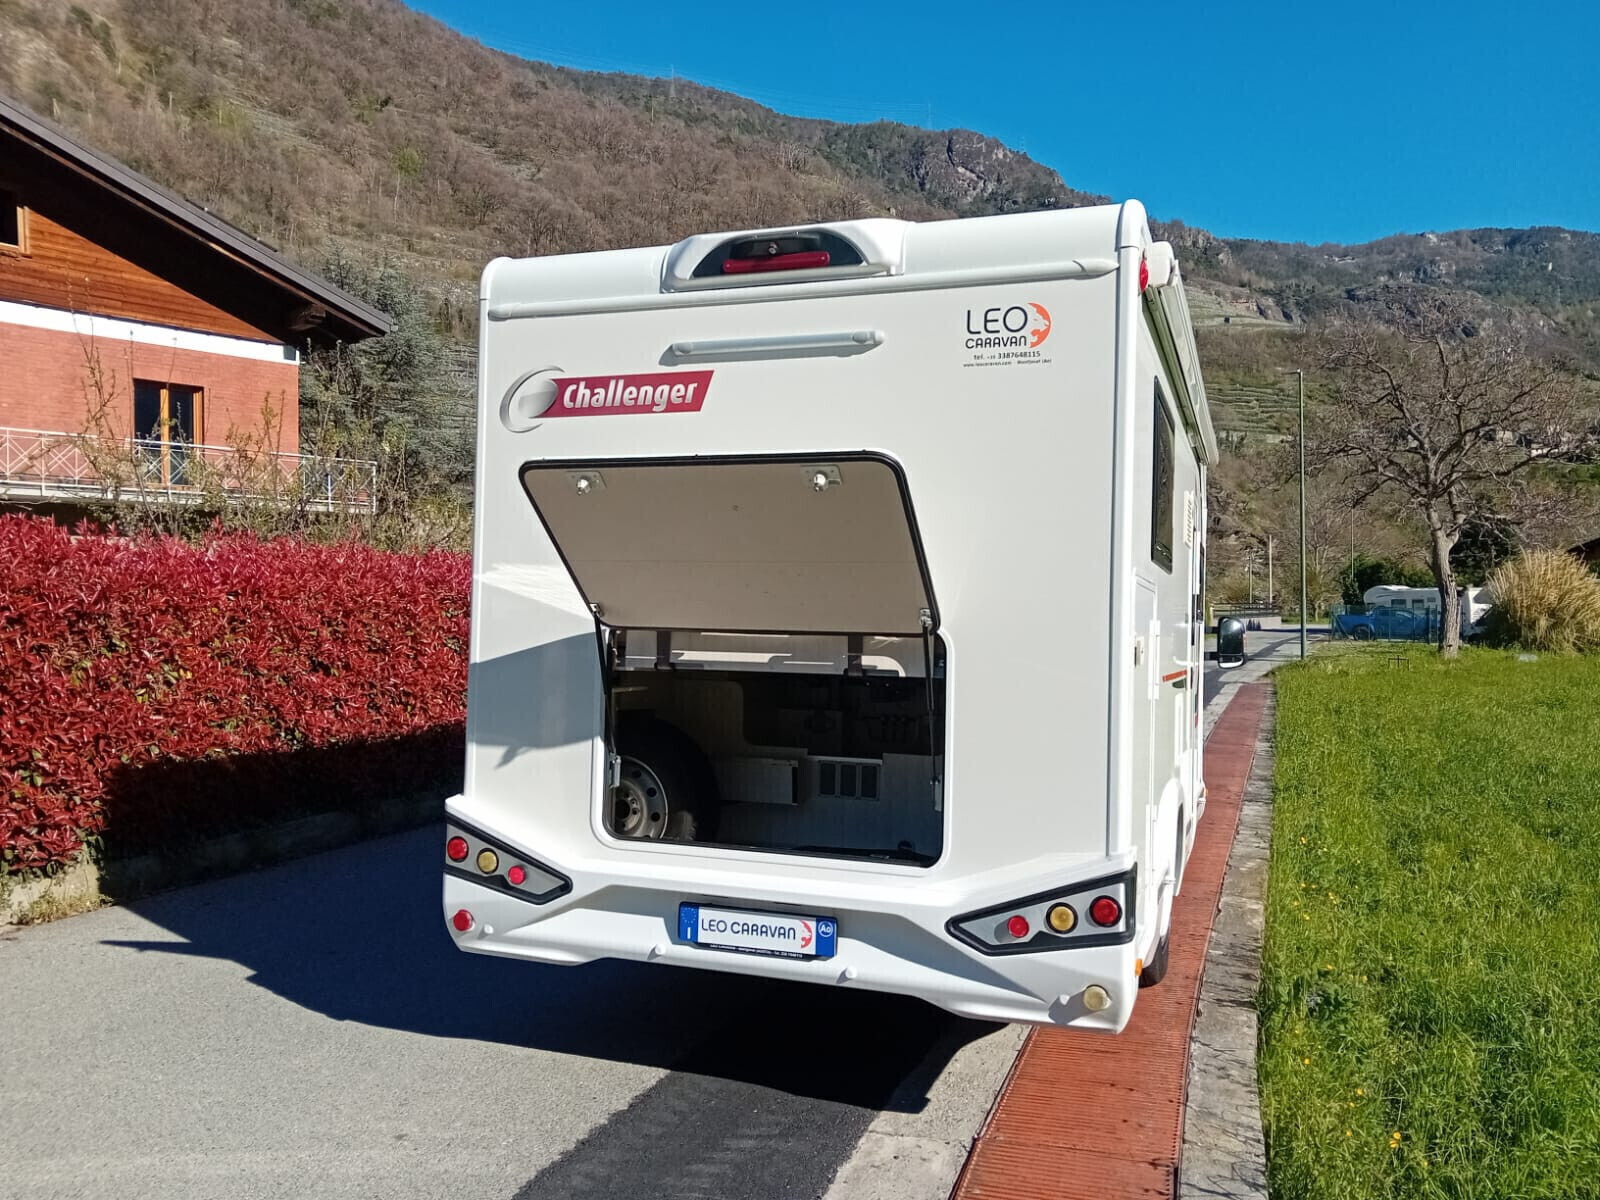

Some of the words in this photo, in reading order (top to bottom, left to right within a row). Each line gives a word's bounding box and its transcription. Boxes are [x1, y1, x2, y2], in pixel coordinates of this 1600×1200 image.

[966, 306, 1028, 334] LEO
[965, 335, 1027, 349] CARAVAN
[563, 379, 698, 412] Challenger
[701, 918, 727, 934] LEO
[731, 921, 796, 940] CARAVAN
